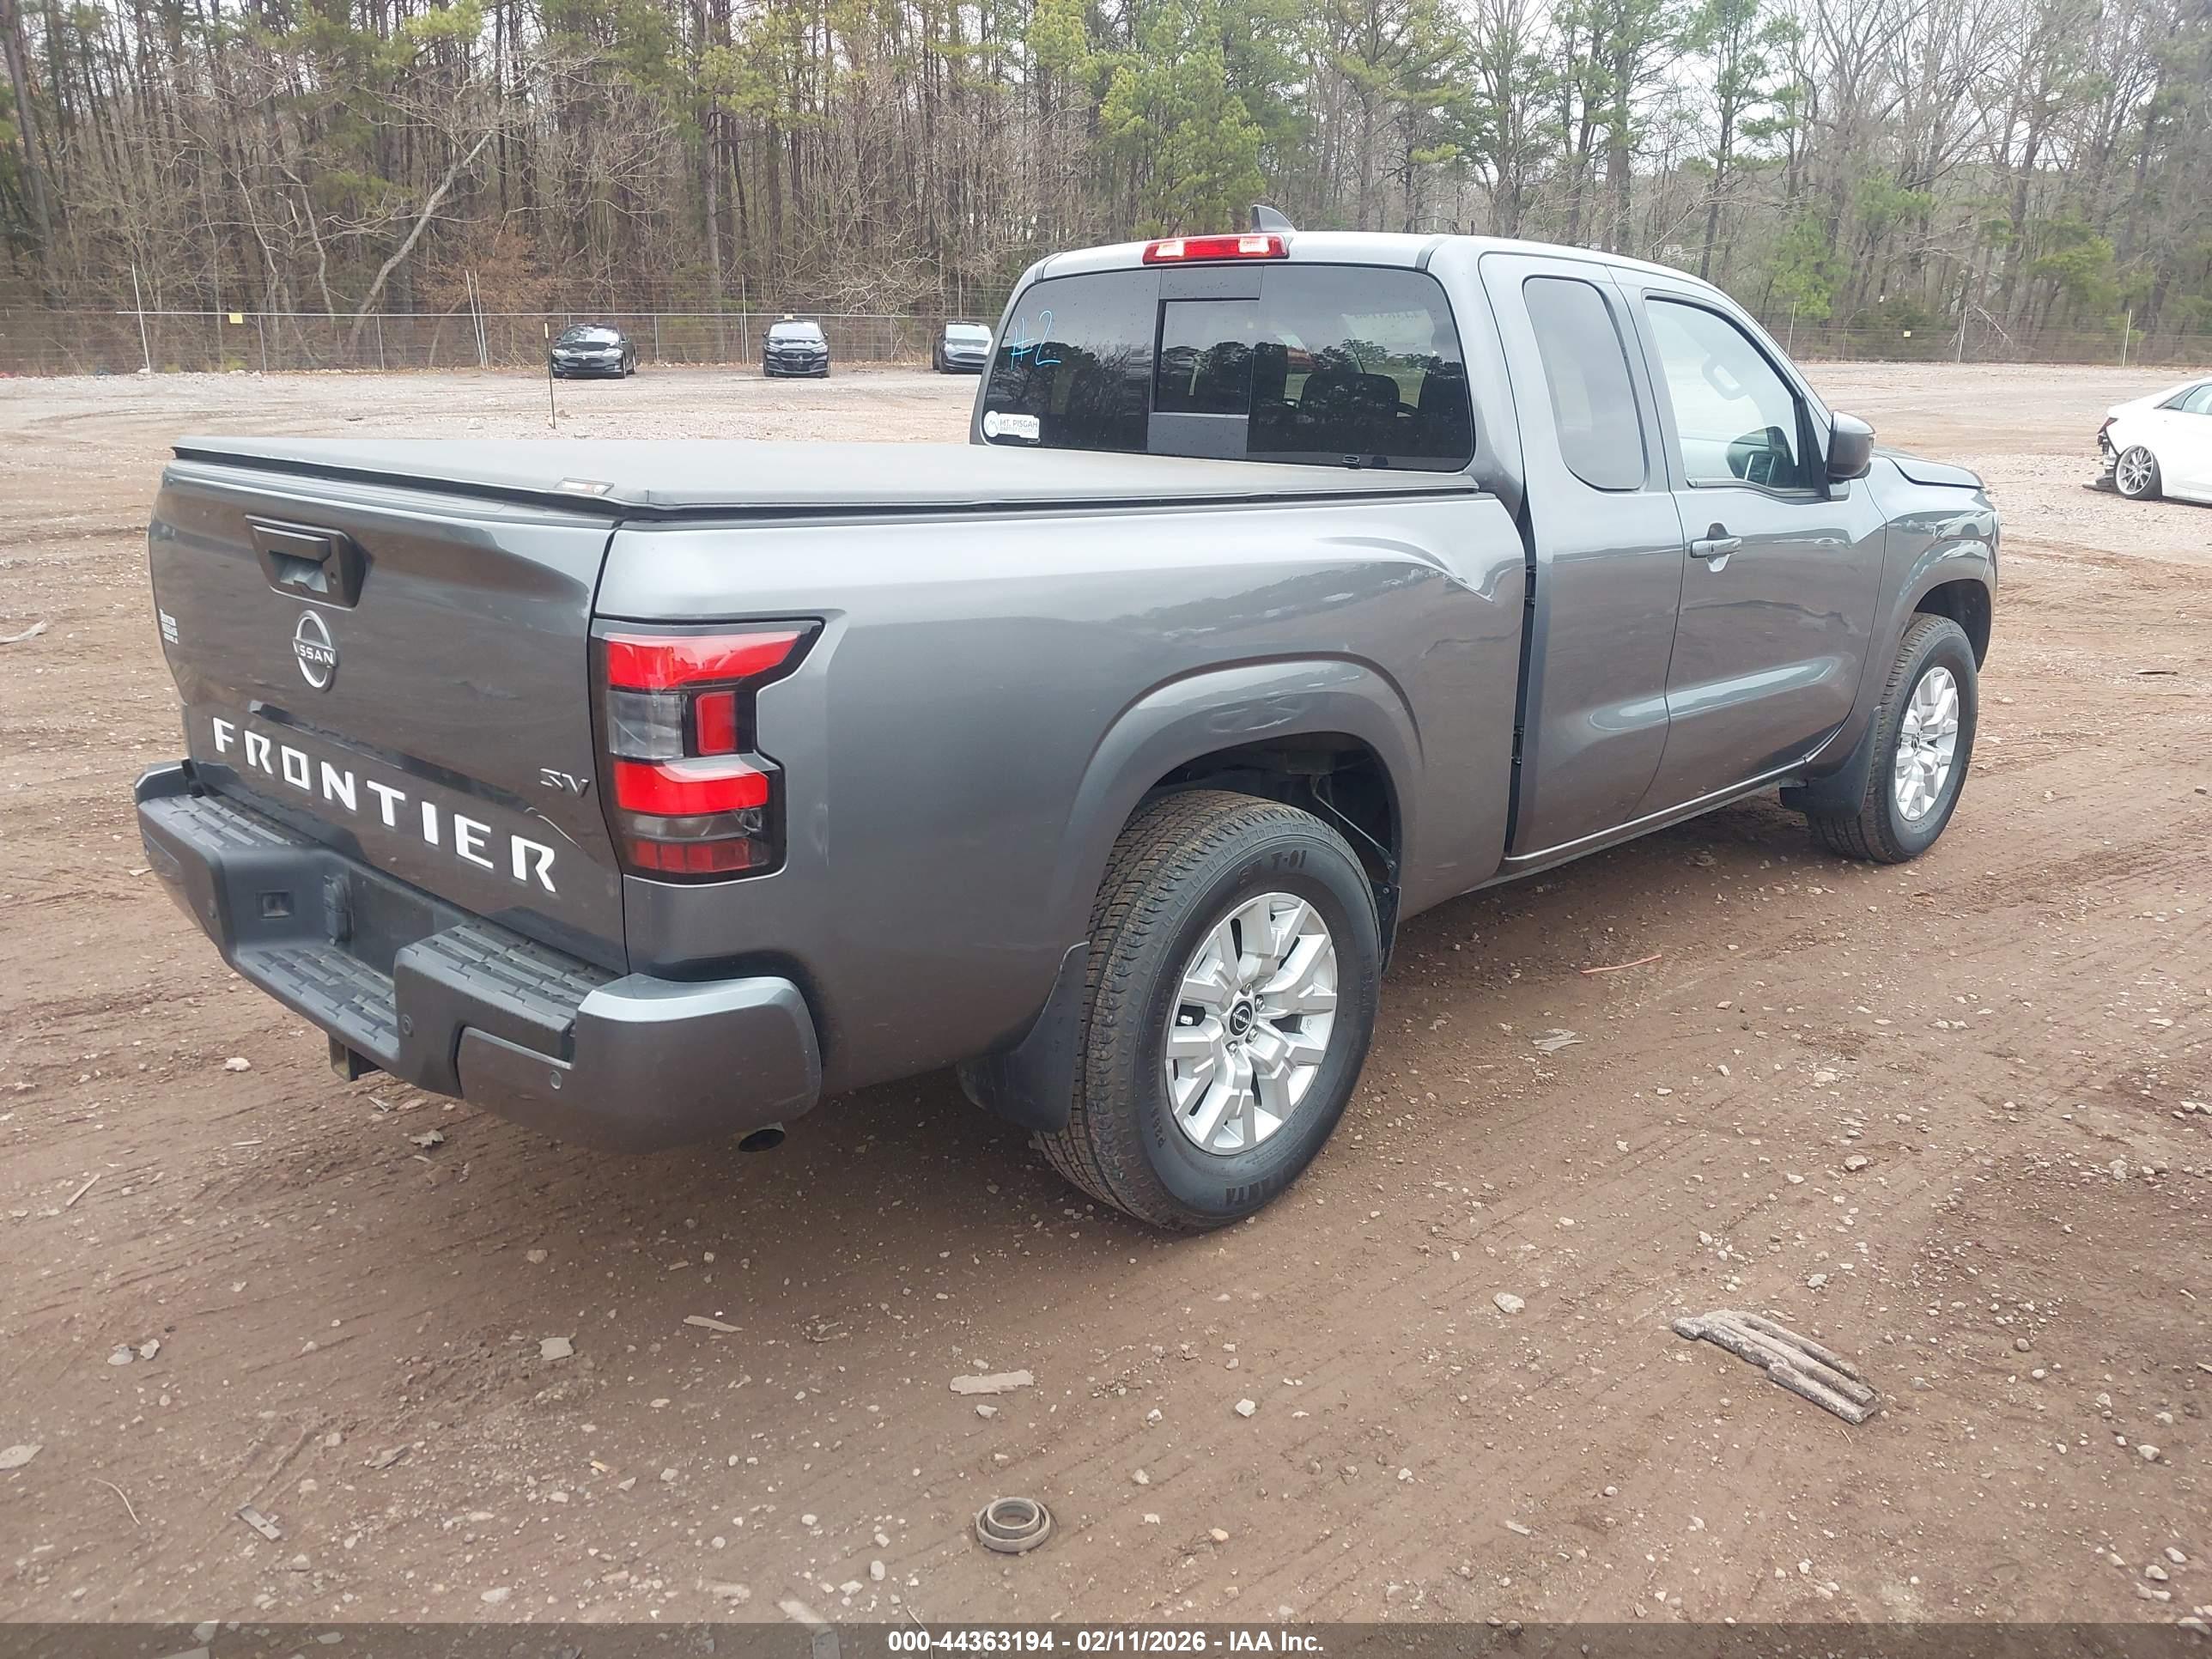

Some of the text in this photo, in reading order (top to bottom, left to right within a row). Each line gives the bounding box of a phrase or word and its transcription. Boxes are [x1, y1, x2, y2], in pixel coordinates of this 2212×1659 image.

[1010, 310, 1061, 371] #2
[1000, 418, 1038, 428] MT. PISGAH
[293, 640, 334, 665] SSAN
[539, 768, 590, 798] SV
[212, 716, 556, 893] FRONTIER
